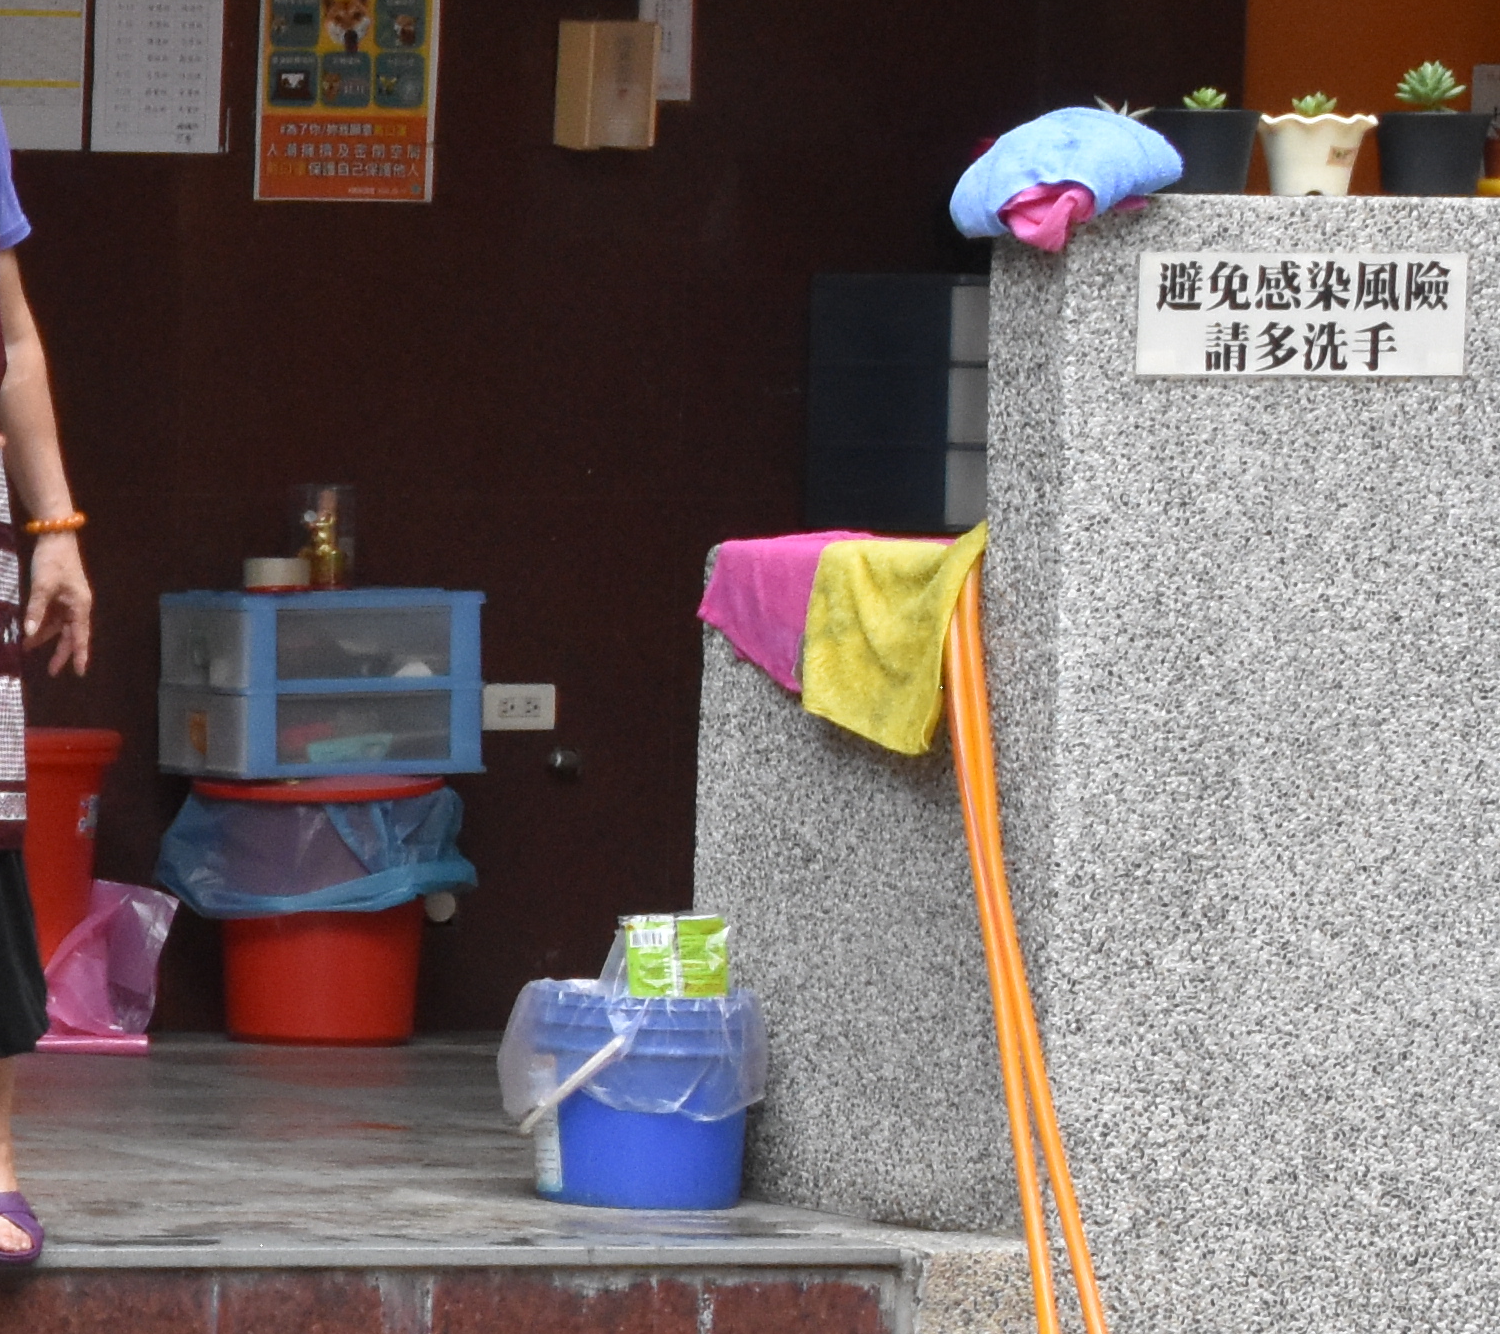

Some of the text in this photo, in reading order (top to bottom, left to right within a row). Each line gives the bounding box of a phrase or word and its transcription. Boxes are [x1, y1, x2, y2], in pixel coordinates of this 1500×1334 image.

[1156, 261, 1451, 312] 避免感染風險
[1205, 322, 1398, 372] 請多洗手
